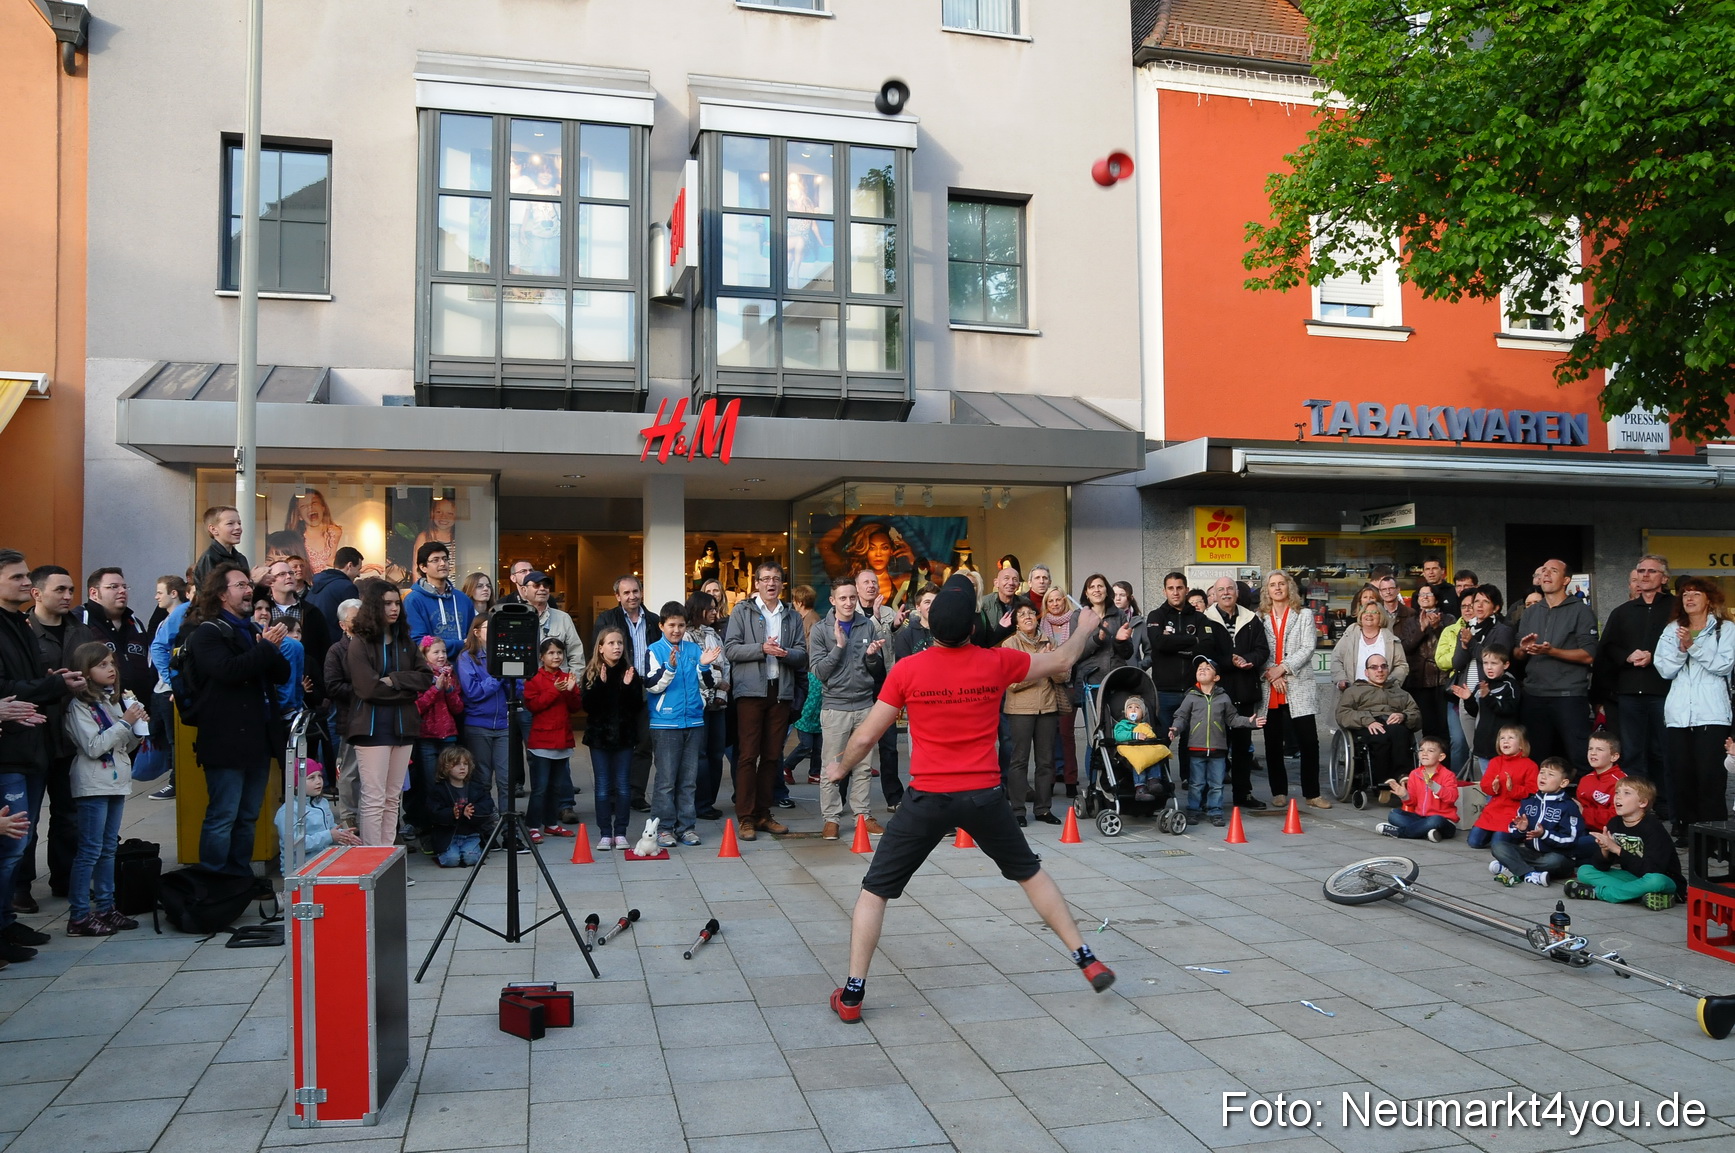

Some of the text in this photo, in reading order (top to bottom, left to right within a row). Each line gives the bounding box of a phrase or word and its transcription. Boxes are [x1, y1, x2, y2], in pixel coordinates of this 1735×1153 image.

[1303, 399, 1589, 446] TABAKWAREN
[640, 397, 741, 465] H&M
[1621, 431, 1664, 443] THUMANN
[1362, 514, 1380, 527] NZ
[1200, 537, 1240, 549] LOTTO
[1209, 552, 1232, 561] Bayern
[1709, 553, 1735, 567] SC
[912, 685, 1000, 698] Comedy Jonglage
